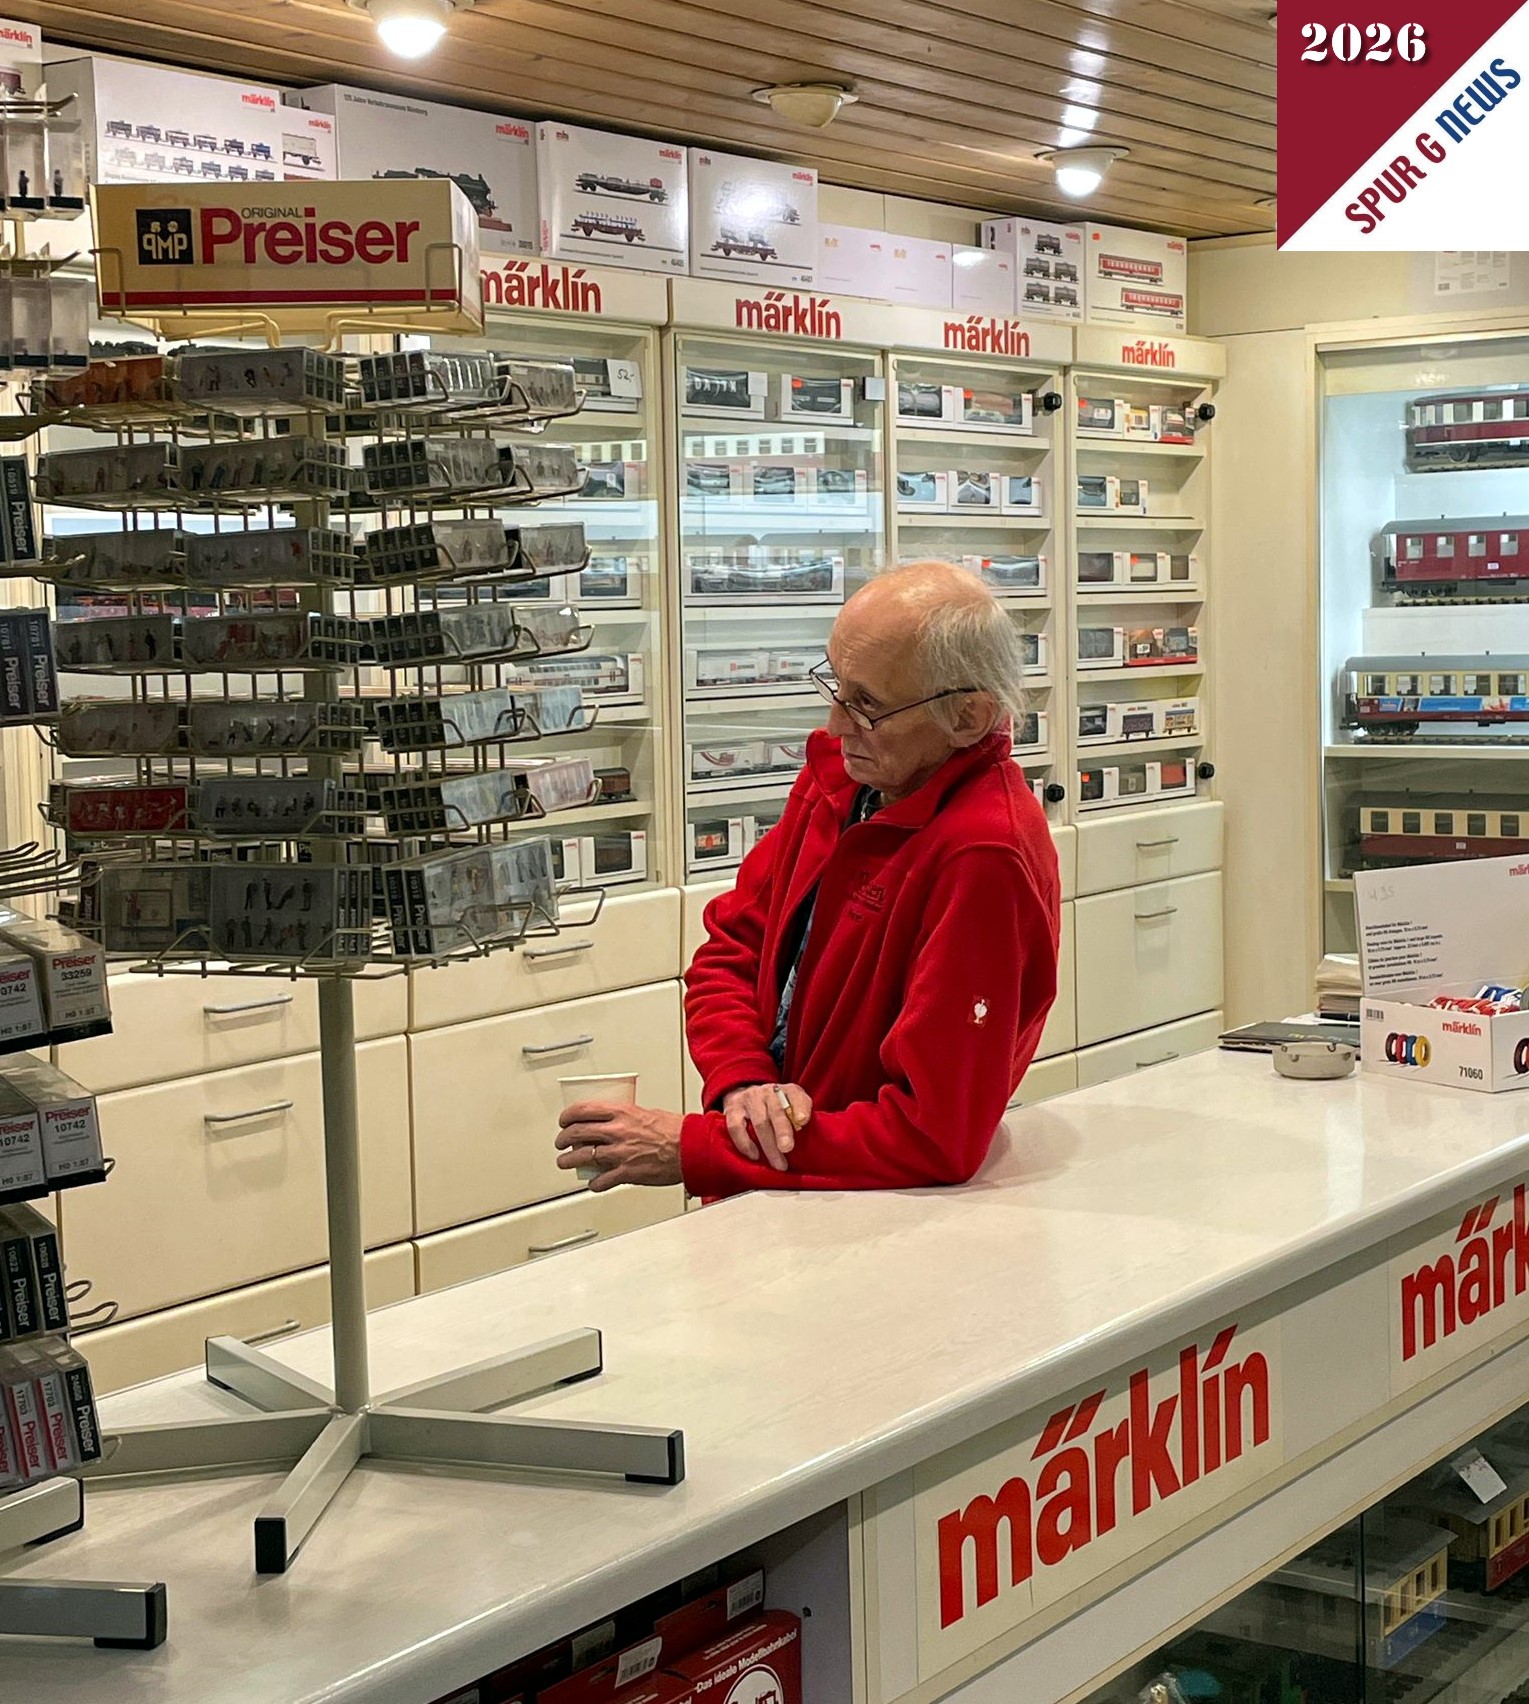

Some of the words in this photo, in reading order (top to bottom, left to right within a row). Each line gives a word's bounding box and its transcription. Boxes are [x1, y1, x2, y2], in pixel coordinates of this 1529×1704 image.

[200, 206, 420, 265] Preiser
[241, 207, 303, 219] ORIGINAL
[480, 260, 602, 313] märklin
[735, 290, 841, 340] märklin
[944, 315, 1030, 357] märklin
[1122, 340, 1176, 368] märklin
[11, 501, 28, 553] Preiser
[4, 657, 21, 709] Preiser
[34, 654, 50, 706] Preiser
[0, 969, 30, 984] eiser
[52, 954, 96, 970] Preiser
[61, 968, 92, 981] 33259
[0, 983, 26, 996] 0742
[1442, 1021, 1482, 1036] märklin
[1458, 1066, 1484, 1080] 71060
[45, 1106, 90, 1123] Preiser
[54, 1120, 86, 1133] 10742
[12, 1277, 30, 1327] Preiser
[43, 1272, 60, 1321] Preiser
[22, 1421, 41, 1468] Preiser
[50, 1412, 68, 1460] Preiser
[76, 1404, 95, 1454] Preiser
[937, 1323, 1270, 1630] märklin
